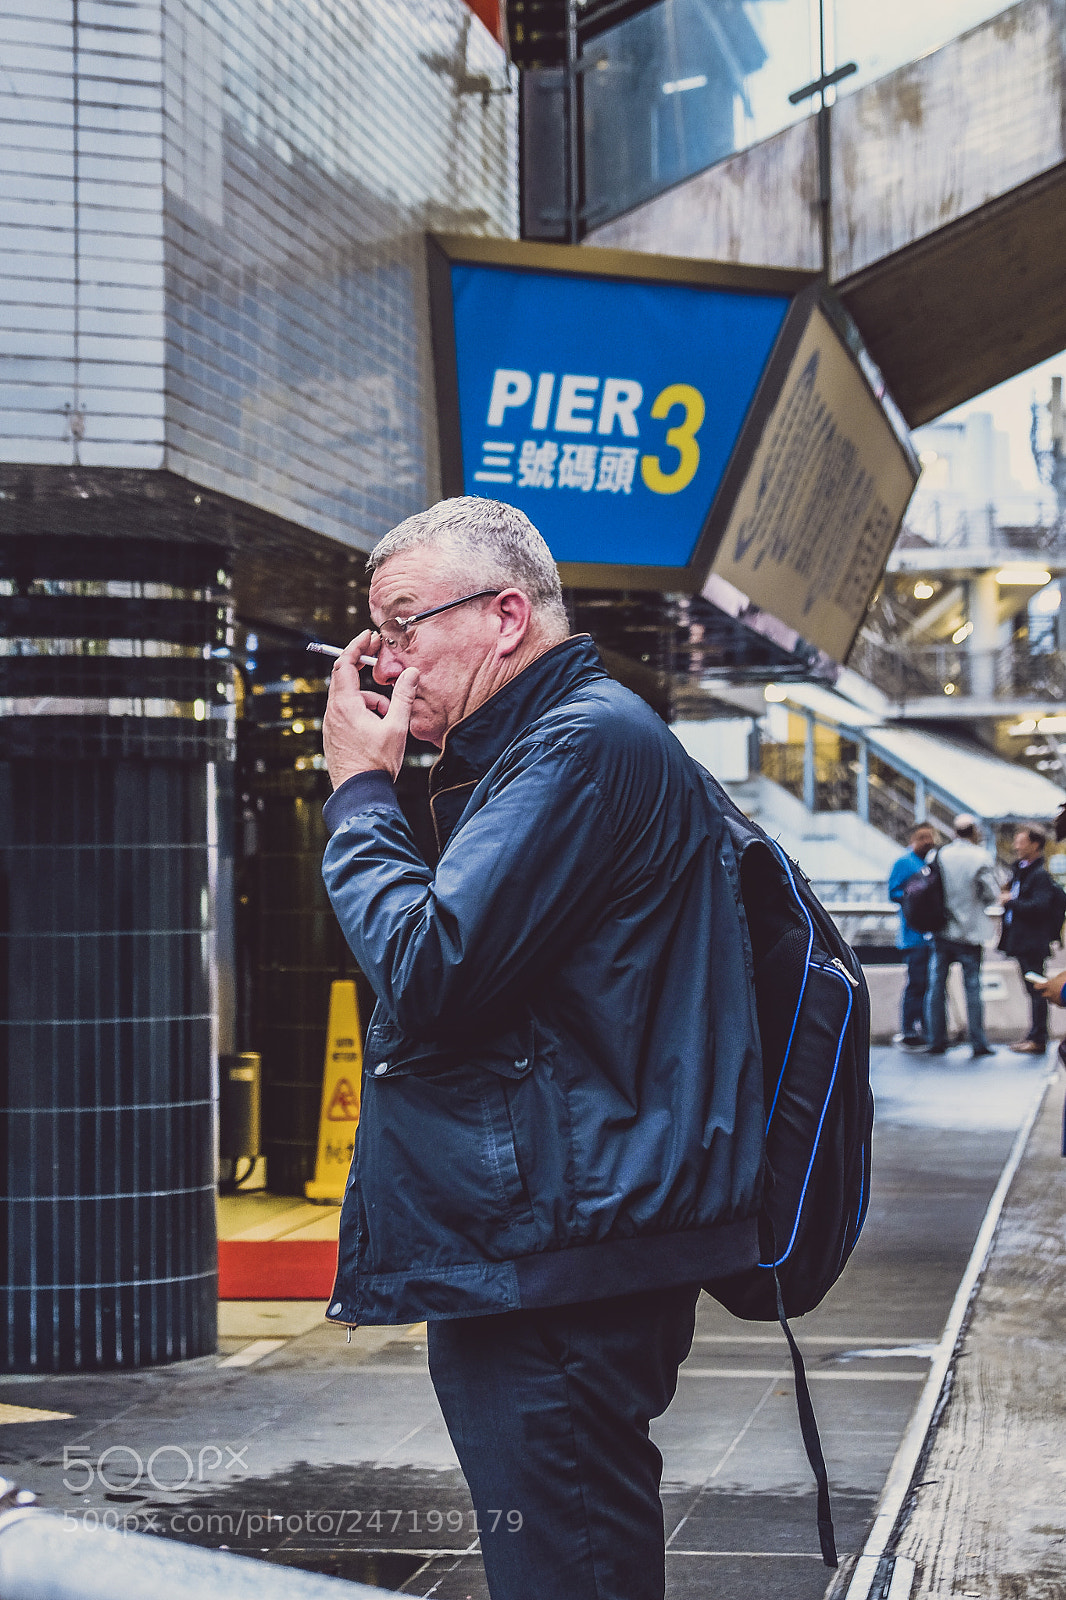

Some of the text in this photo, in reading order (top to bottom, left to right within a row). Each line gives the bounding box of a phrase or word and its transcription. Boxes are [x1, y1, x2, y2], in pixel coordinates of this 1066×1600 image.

[475, 441, 638, 494] 三號碼頭
[486, 369, 706, 495] PIER 3
